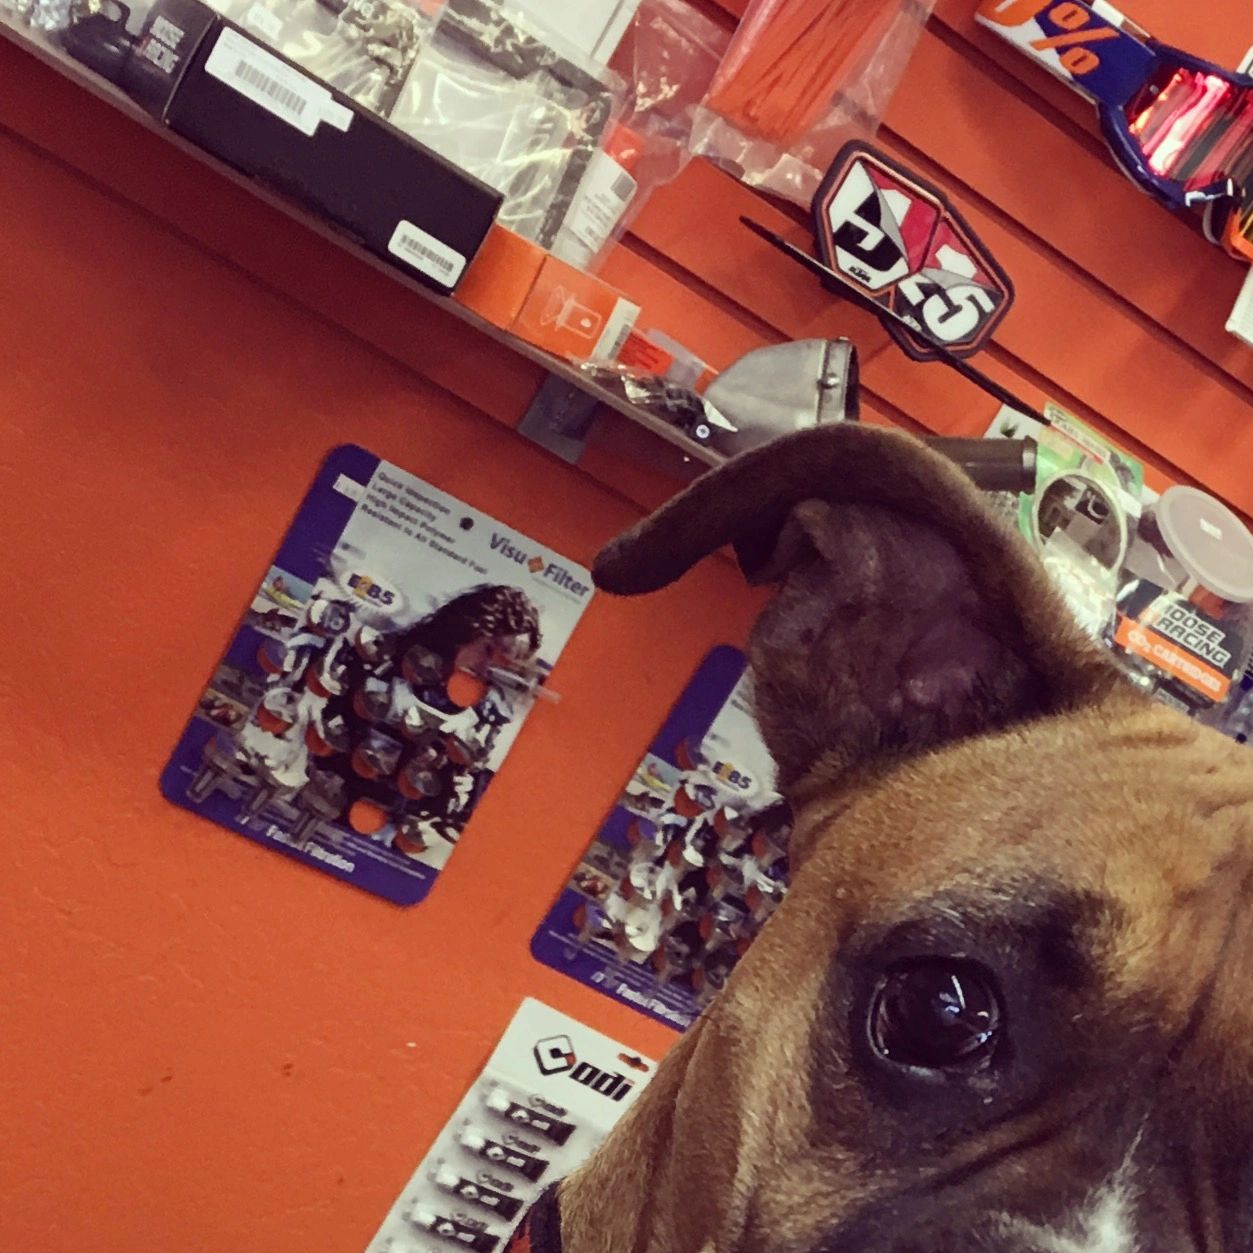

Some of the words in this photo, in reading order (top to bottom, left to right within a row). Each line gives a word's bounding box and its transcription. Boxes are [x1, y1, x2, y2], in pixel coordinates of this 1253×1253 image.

[489, 531, 529, 566] Visu
[543, 562, 590, 598] Filter
[1156, 617, 1229, 665] RACING
